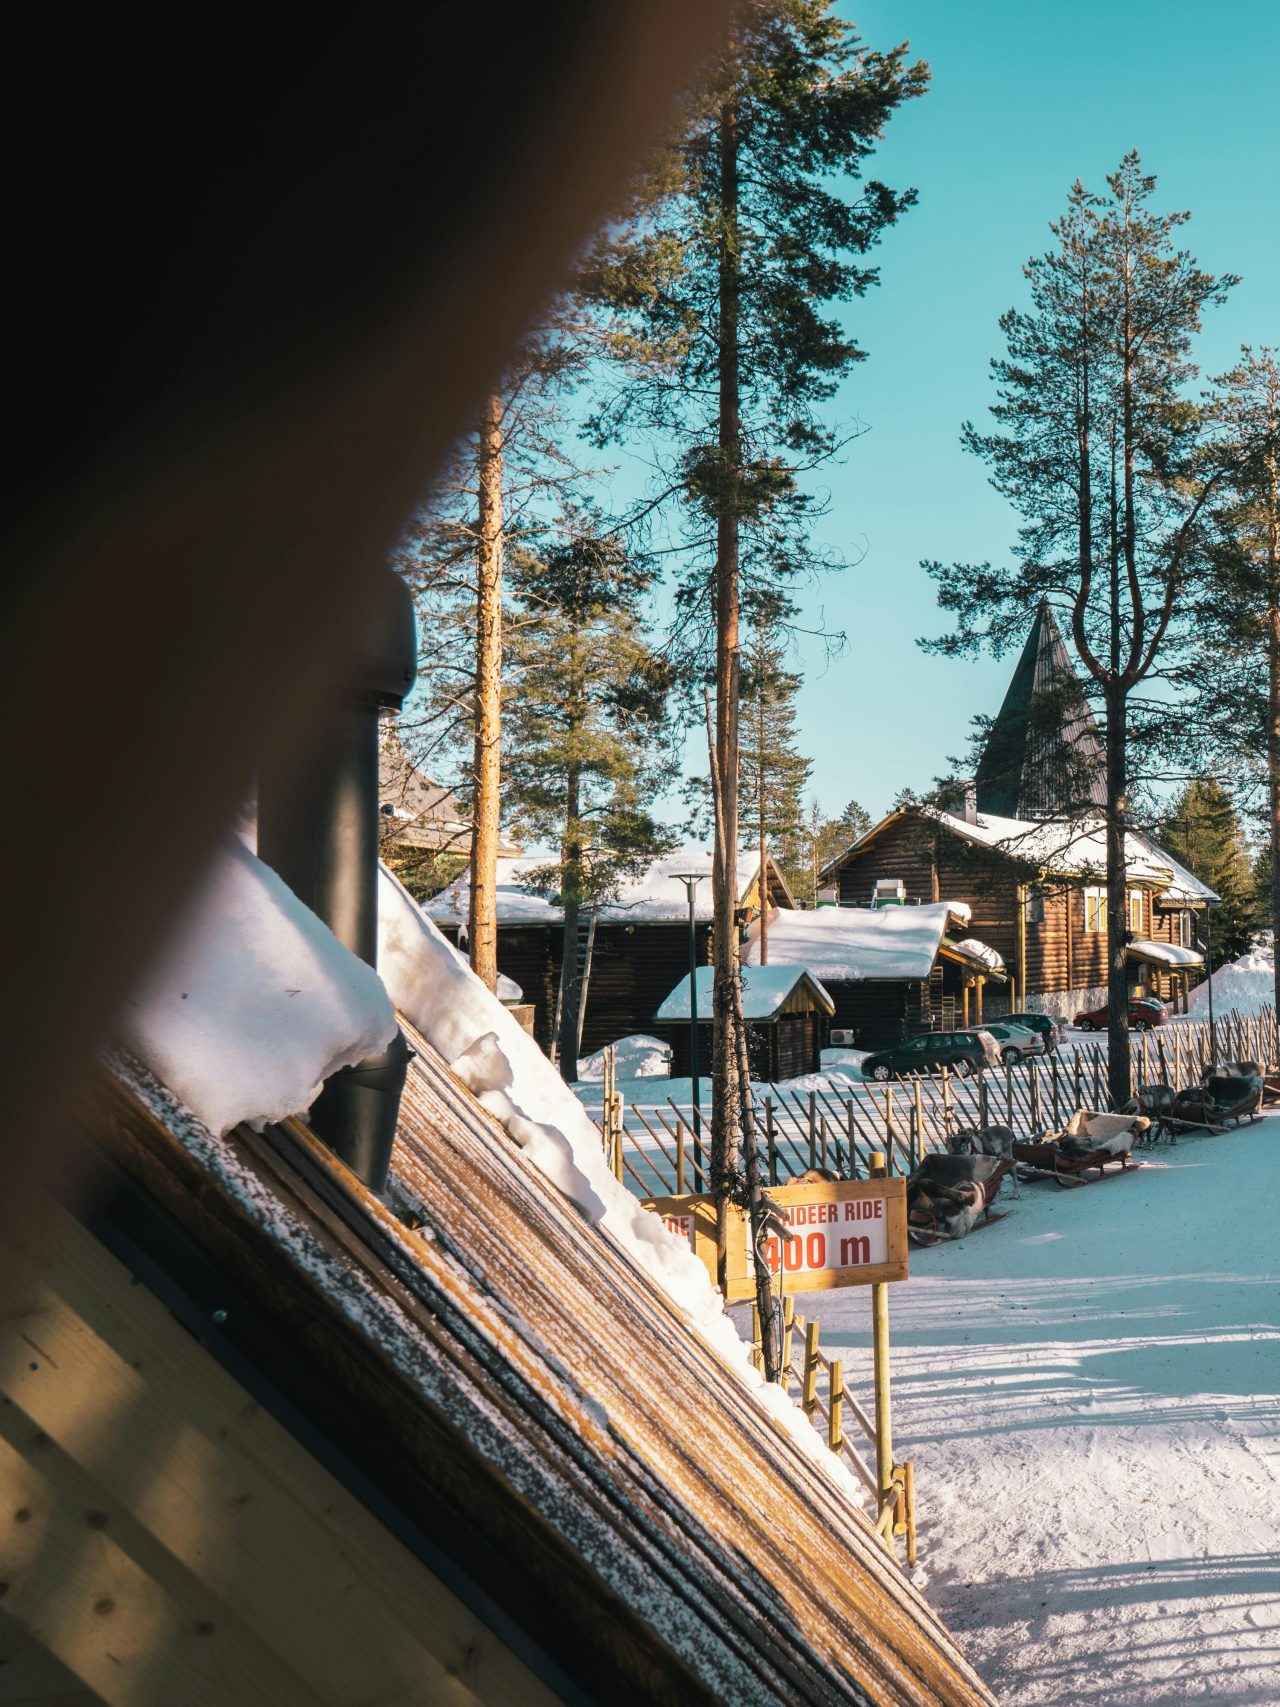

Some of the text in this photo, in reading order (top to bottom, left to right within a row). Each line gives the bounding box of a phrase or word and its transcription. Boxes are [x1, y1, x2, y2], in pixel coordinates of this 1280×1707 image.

[774, 1200, 882, 1227] NDEER RIDE
[766, 1232, 871, 1274] 400 m
